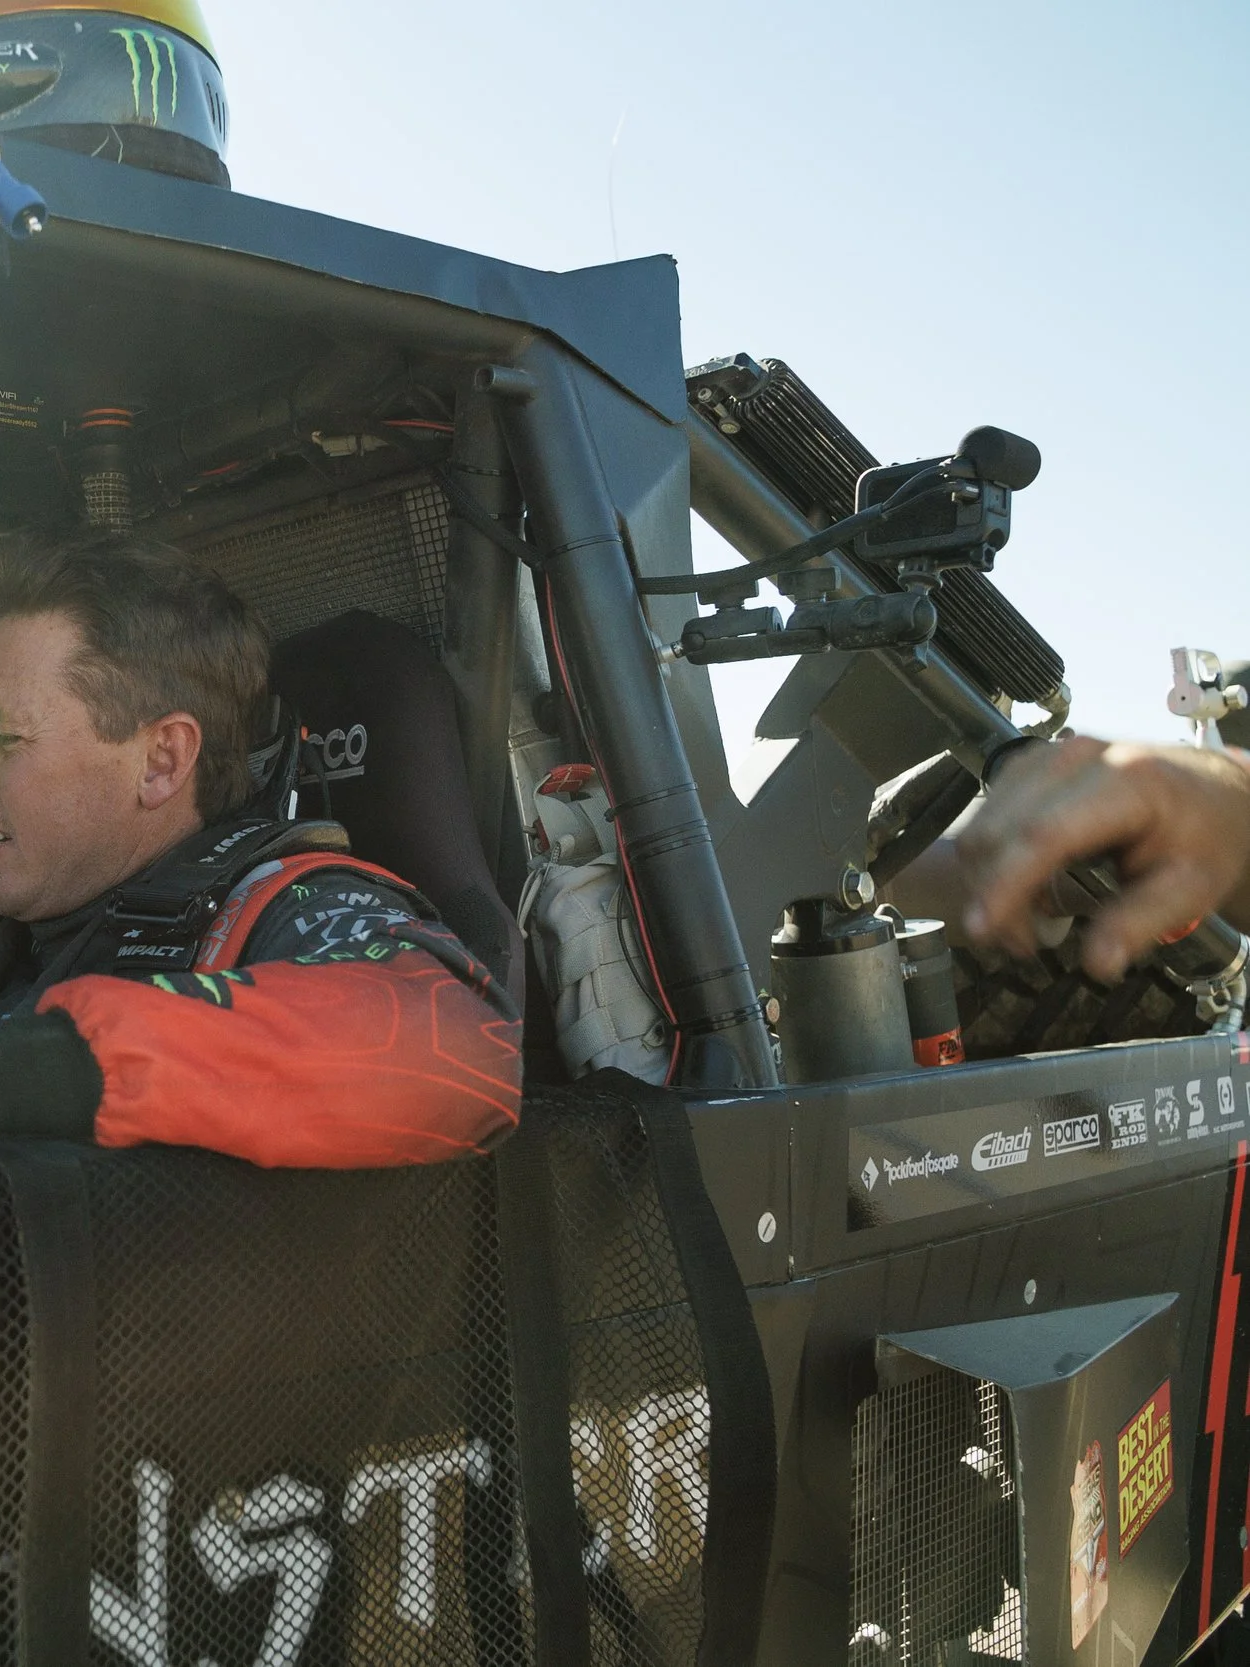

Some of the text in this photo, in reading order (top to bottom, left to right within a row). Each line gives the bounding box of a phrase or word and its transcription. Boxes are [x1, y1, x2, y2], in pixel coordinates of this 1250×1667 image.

[971, 1126, 1032, 1171] Eibach
[1111, 1133, 1147, 1149] ENDS
[1118, 1122, 1146, 1137] ROD
[883, 1156, 925, 1187] Rockford
[1118, 1401, 1155, 1485] BEST
[1159, 1411, 1170, 1436] THE
[1119, 1432, 1171, 1537] DESERT
[1140, 1479, 1173, 1525] ASSOCIATION
